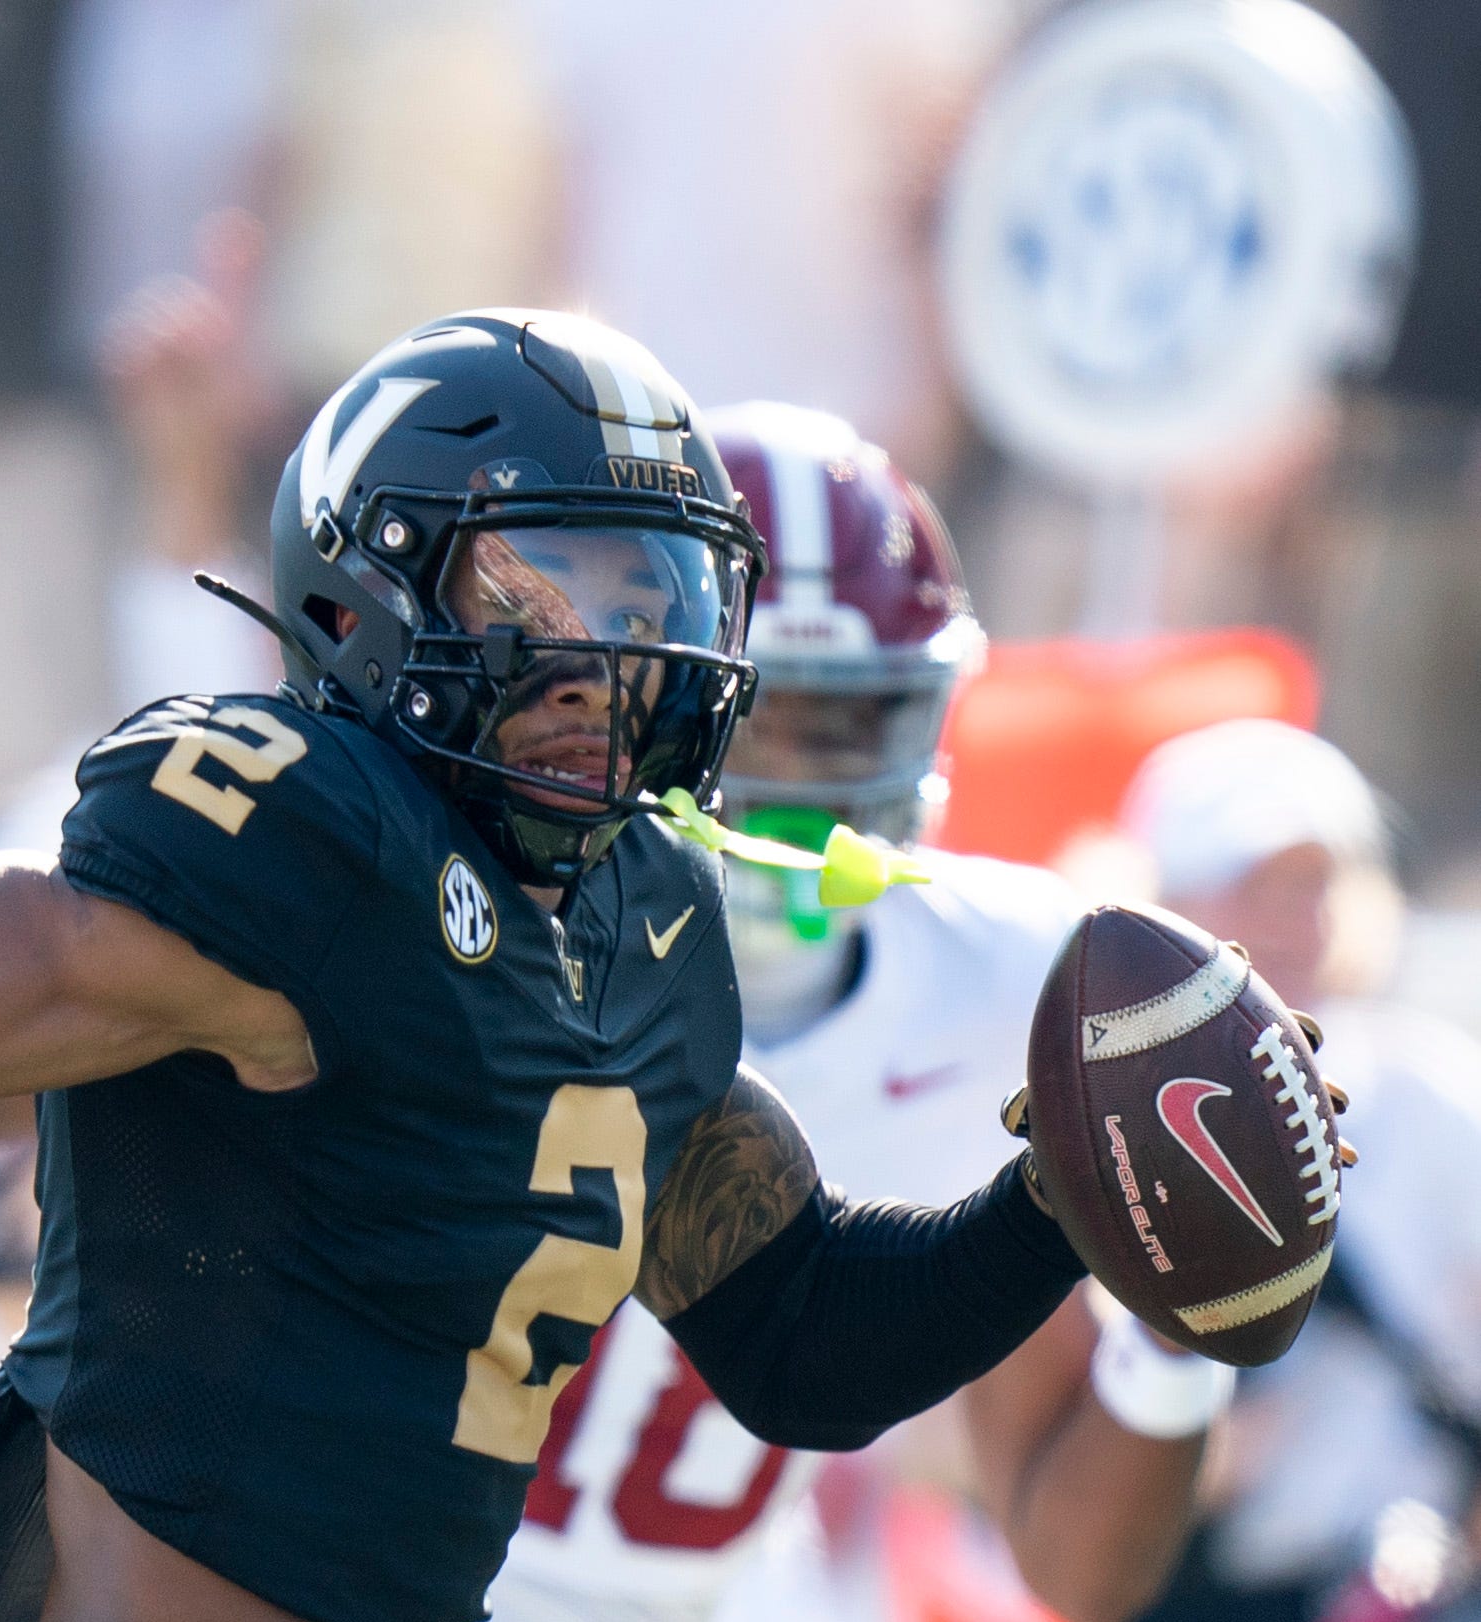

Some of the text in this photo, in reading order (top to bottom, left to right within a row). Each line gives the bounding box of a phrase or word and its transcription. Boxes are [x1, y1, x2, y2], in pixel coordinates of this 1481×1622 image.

[150, 704, 308, 837] 2
[444, 860, 494, 956] SEC
[1104, 1114, 1174, 1273] VAPOR ELITE
[451, 1082, 648, 1465] 2
